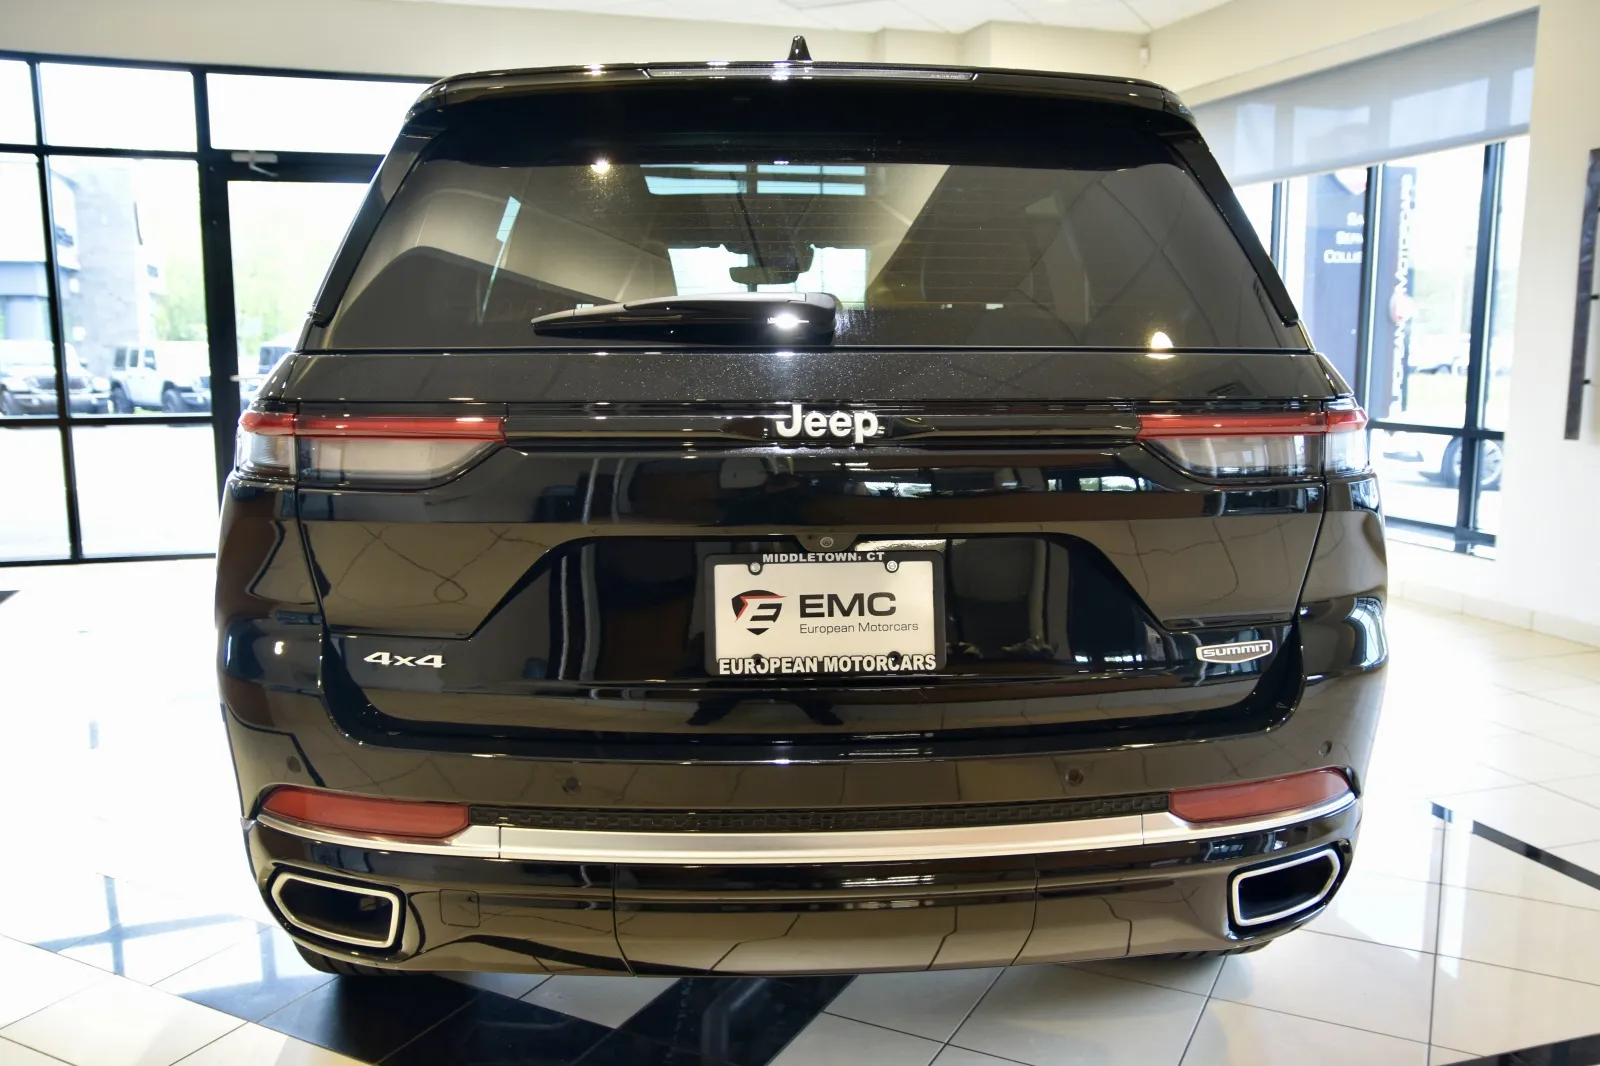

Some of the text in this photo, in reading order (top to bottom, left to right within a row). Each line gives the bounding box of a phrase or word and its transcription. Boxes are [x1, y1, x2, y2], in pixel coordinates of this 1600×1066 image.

[776, 403, 879, 444] Jeep
[762, 551, 885, 563] MIDDLETOWN, CT
[799, 592, 897, 618] EMC
[799, 621, 919, 636] European Motorcars
[1203, 643, 1269, 658] SUMMIT
[363, 651, 447, 668] 4x4
[718, 654, 937, 675] EUROPEAN MOTORCARS
